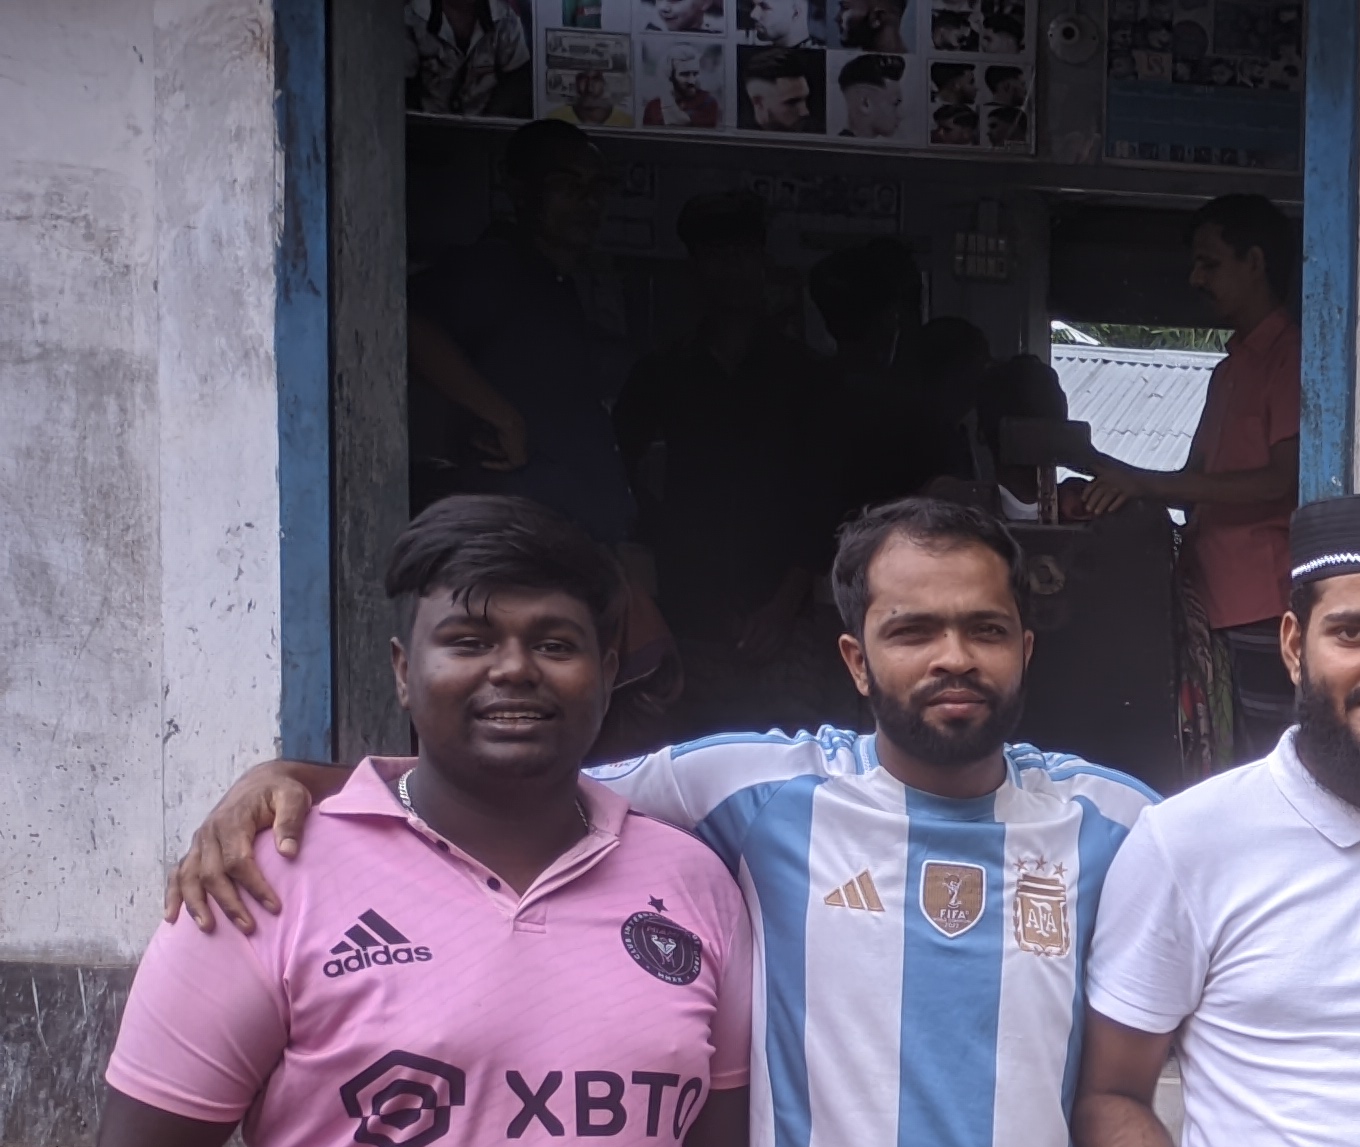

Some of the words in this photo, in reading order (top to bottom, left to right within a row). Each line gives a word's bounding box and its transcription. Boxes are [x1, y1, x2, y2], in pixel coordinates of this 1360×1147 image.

[939, 908, 966, 920] FIFA
[1025, 898, 1058, 937] AFA
[322, 942, 433, 978] adidas
[505, 1069, 703, 1140] XBTO
